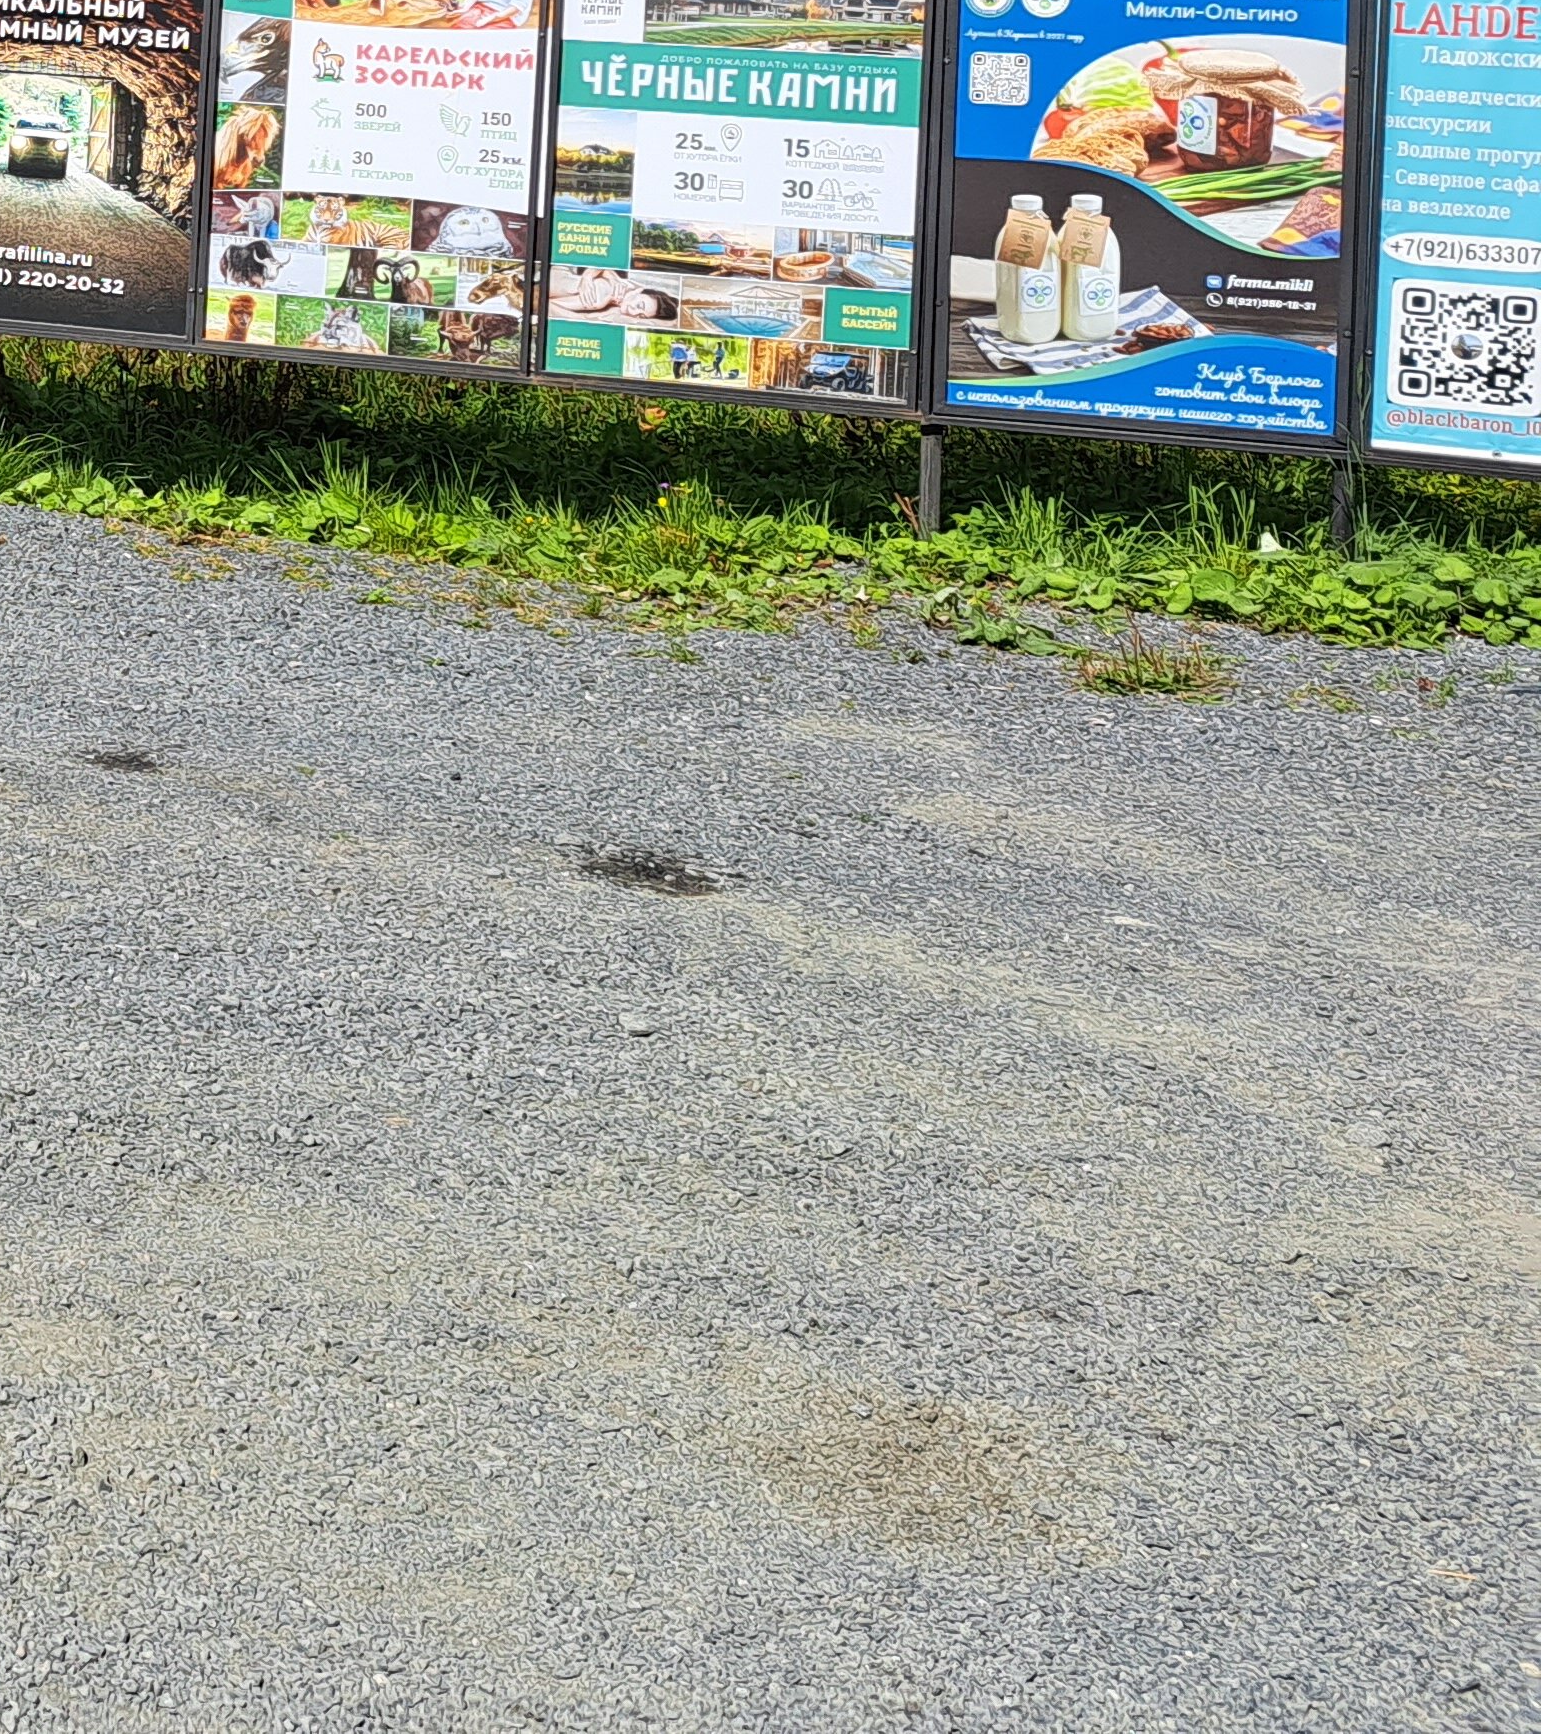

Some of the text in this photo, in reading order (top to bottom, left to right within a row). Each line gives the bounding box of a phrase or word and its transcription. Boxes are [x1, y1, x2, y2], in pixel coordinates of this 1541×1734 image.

[580, 3, 622, 16] КАМНИ
[1125, 1, 1299, 22] Микли-Ольгино
[96, 26, 191, 50] МУЗЕЙ
[356, 44, 535, 71] КАРЕЛЬСКИЙ
[659, 54, 898, 76] ДОБРО ПОЖАЛОВАТЬ НА БАЗУ ОТДЫХА
[354, 65, 486, 92] ЗООПАРК
[580, 53, 898, 114] ЧЁРНЫЕ КАМНИ
[354, 102, 512, 127] 500 150
[1386, 114, 1494, 137] экскурсии
[353, 120, 518, 143] ЗВЕРЕЙ ПТИЦ
[351, 148, 500, 166] 30 25
[675, 132, 811, 159] 25 15
[1396, 139, 1472, 161] Водные
[350, 165, 525, 183] ГЕКТАРОВ ОТ ХУТОРА
[673, 171, 814, 200] 30 30
[1394, 168, 1486, 193] Северное
[1381, 197, 1512, 221] на вездеходе
[557, 221, 614, 235] РУССКИЕ
[558, 232, 591, 244] БАНИ
[558, 243, 609, 257] ДРОВАХ
[17, 269, 125, 295] 220-20-32
[842, 304, 898, 319] КРЫТЫЙ
[841, 317, 897, 332] БАССЕЙН
[556, 336, 602, 350] ЛЕТНИЕ
[1196, 362, 1325, 392] Клуб Берлога
[955, 389, 1328, 431] с использованием продукции нашего хозяйства
[1153, 382, 1324, 416] готовит свои блюда
